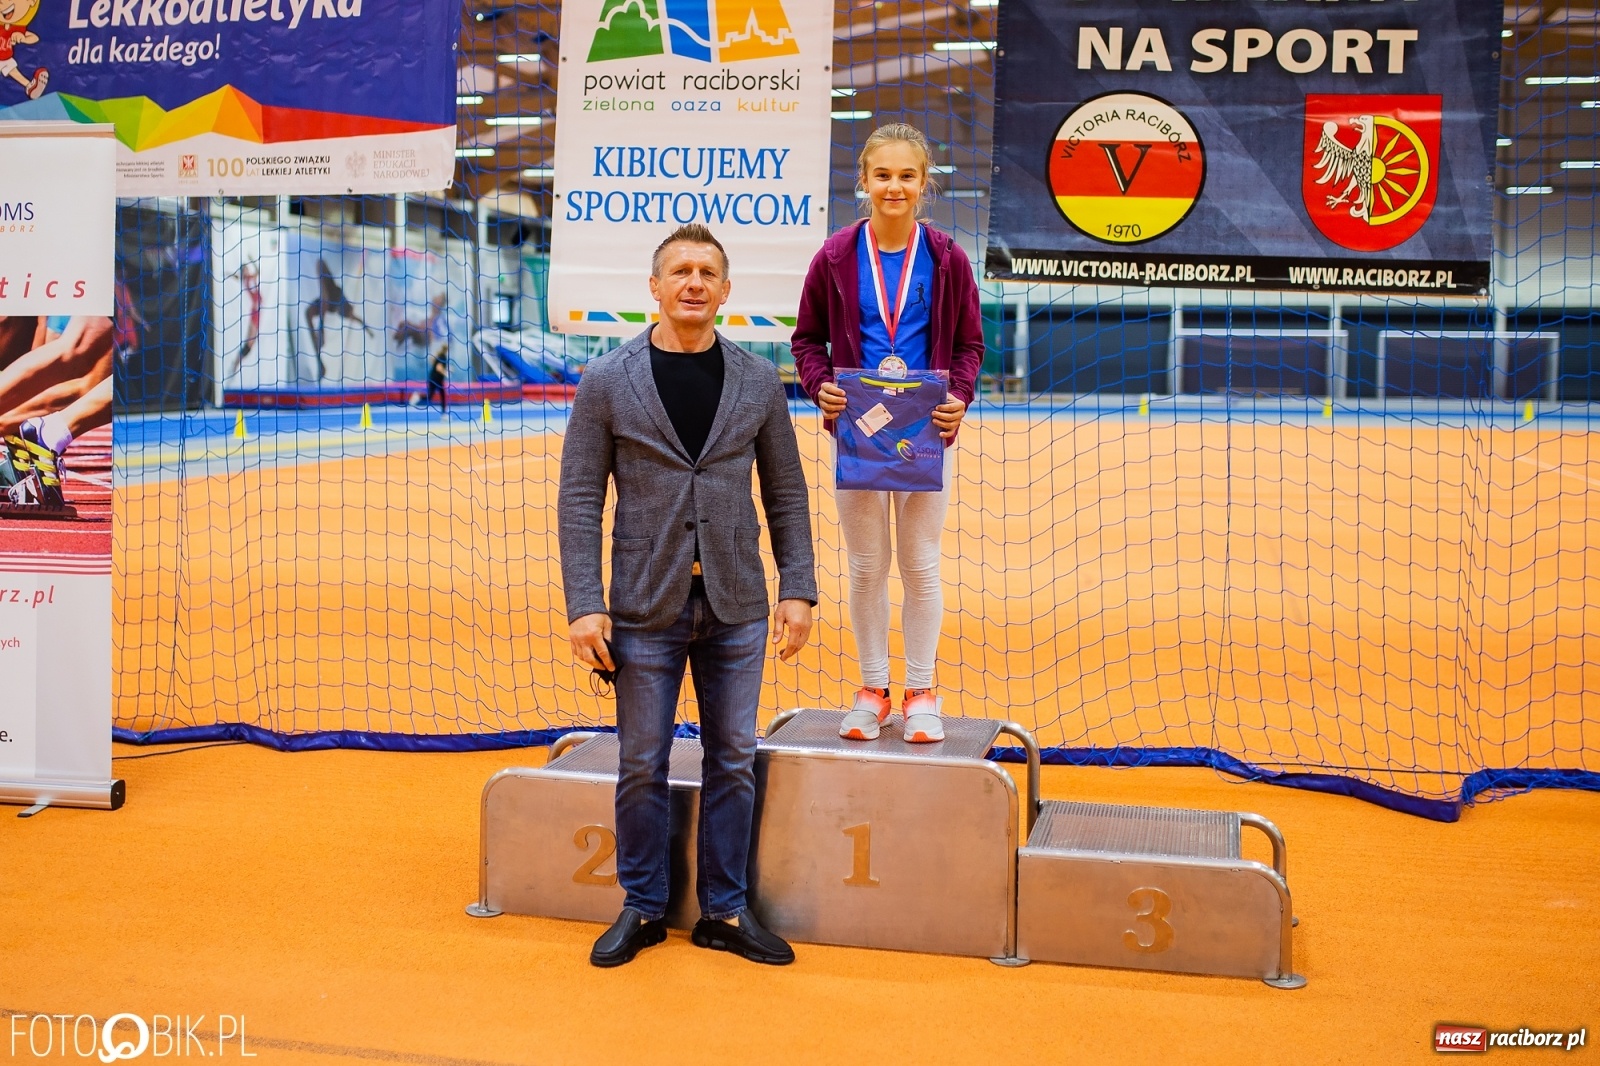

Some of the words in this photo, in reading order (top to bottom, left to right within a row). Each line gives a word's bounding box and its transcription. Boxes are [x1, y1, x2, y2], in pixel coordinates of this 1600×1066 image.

[68, 37, 103, 65] dla
[109, 33, 221, 67] każdego!
[1077, 27, 1173, 72] NA
[1190, 28, 1419, 74] SPORT
[584, 68, 666, 96] powiat
[683, 69, 801, 91] raciborski
[582, 97, 655, 112] zielona
[671, 100, 722, 112] oaza
[737, 98, 800, 112] kultur
[1061, 109, 1121, 160] VICTORIA
[1125, 108, 1192, 163] RACIBÓRZ
[246, 156, 291, 165] POLSKIEGO
[294, 155, 331, 165] ZWIĄZKU
[373, 149, 416, 159] MINISTER
[373, 159, 416, 168] EDUKACJI
[207, 158, 245, 177] 100
[246, 168, 260, 177] LAT
[262, 167, 292, 176] LEKKIEJ
[295, 167, 331, 176] ATLETYKI
[373, 168, 430, 179] NARODOWEJ
[593, 146, 791, 187] KIBICUJEMY
[1098, 143, 1153, 196] V
[0, 202, 34, 221] MS
[566, 190, 812, 226] SPORTOWCOM
[1105, 223, 1142, 238] 1970
[1011, 257, 1256, 284] WWW.VICTORIA-RACIBORZ.PL
[1288, 265, 1457, 289] WWW.RACIBORZ.PL
[0, 273, 86, 299] tics
[0, 585, 54, 609] rz.pl
[0, 636, 20, 651] ych
[571, 824, 617, 887] 2
[842, 822, 880, 888] 1
[1122, 886, 1176, 955] 3
